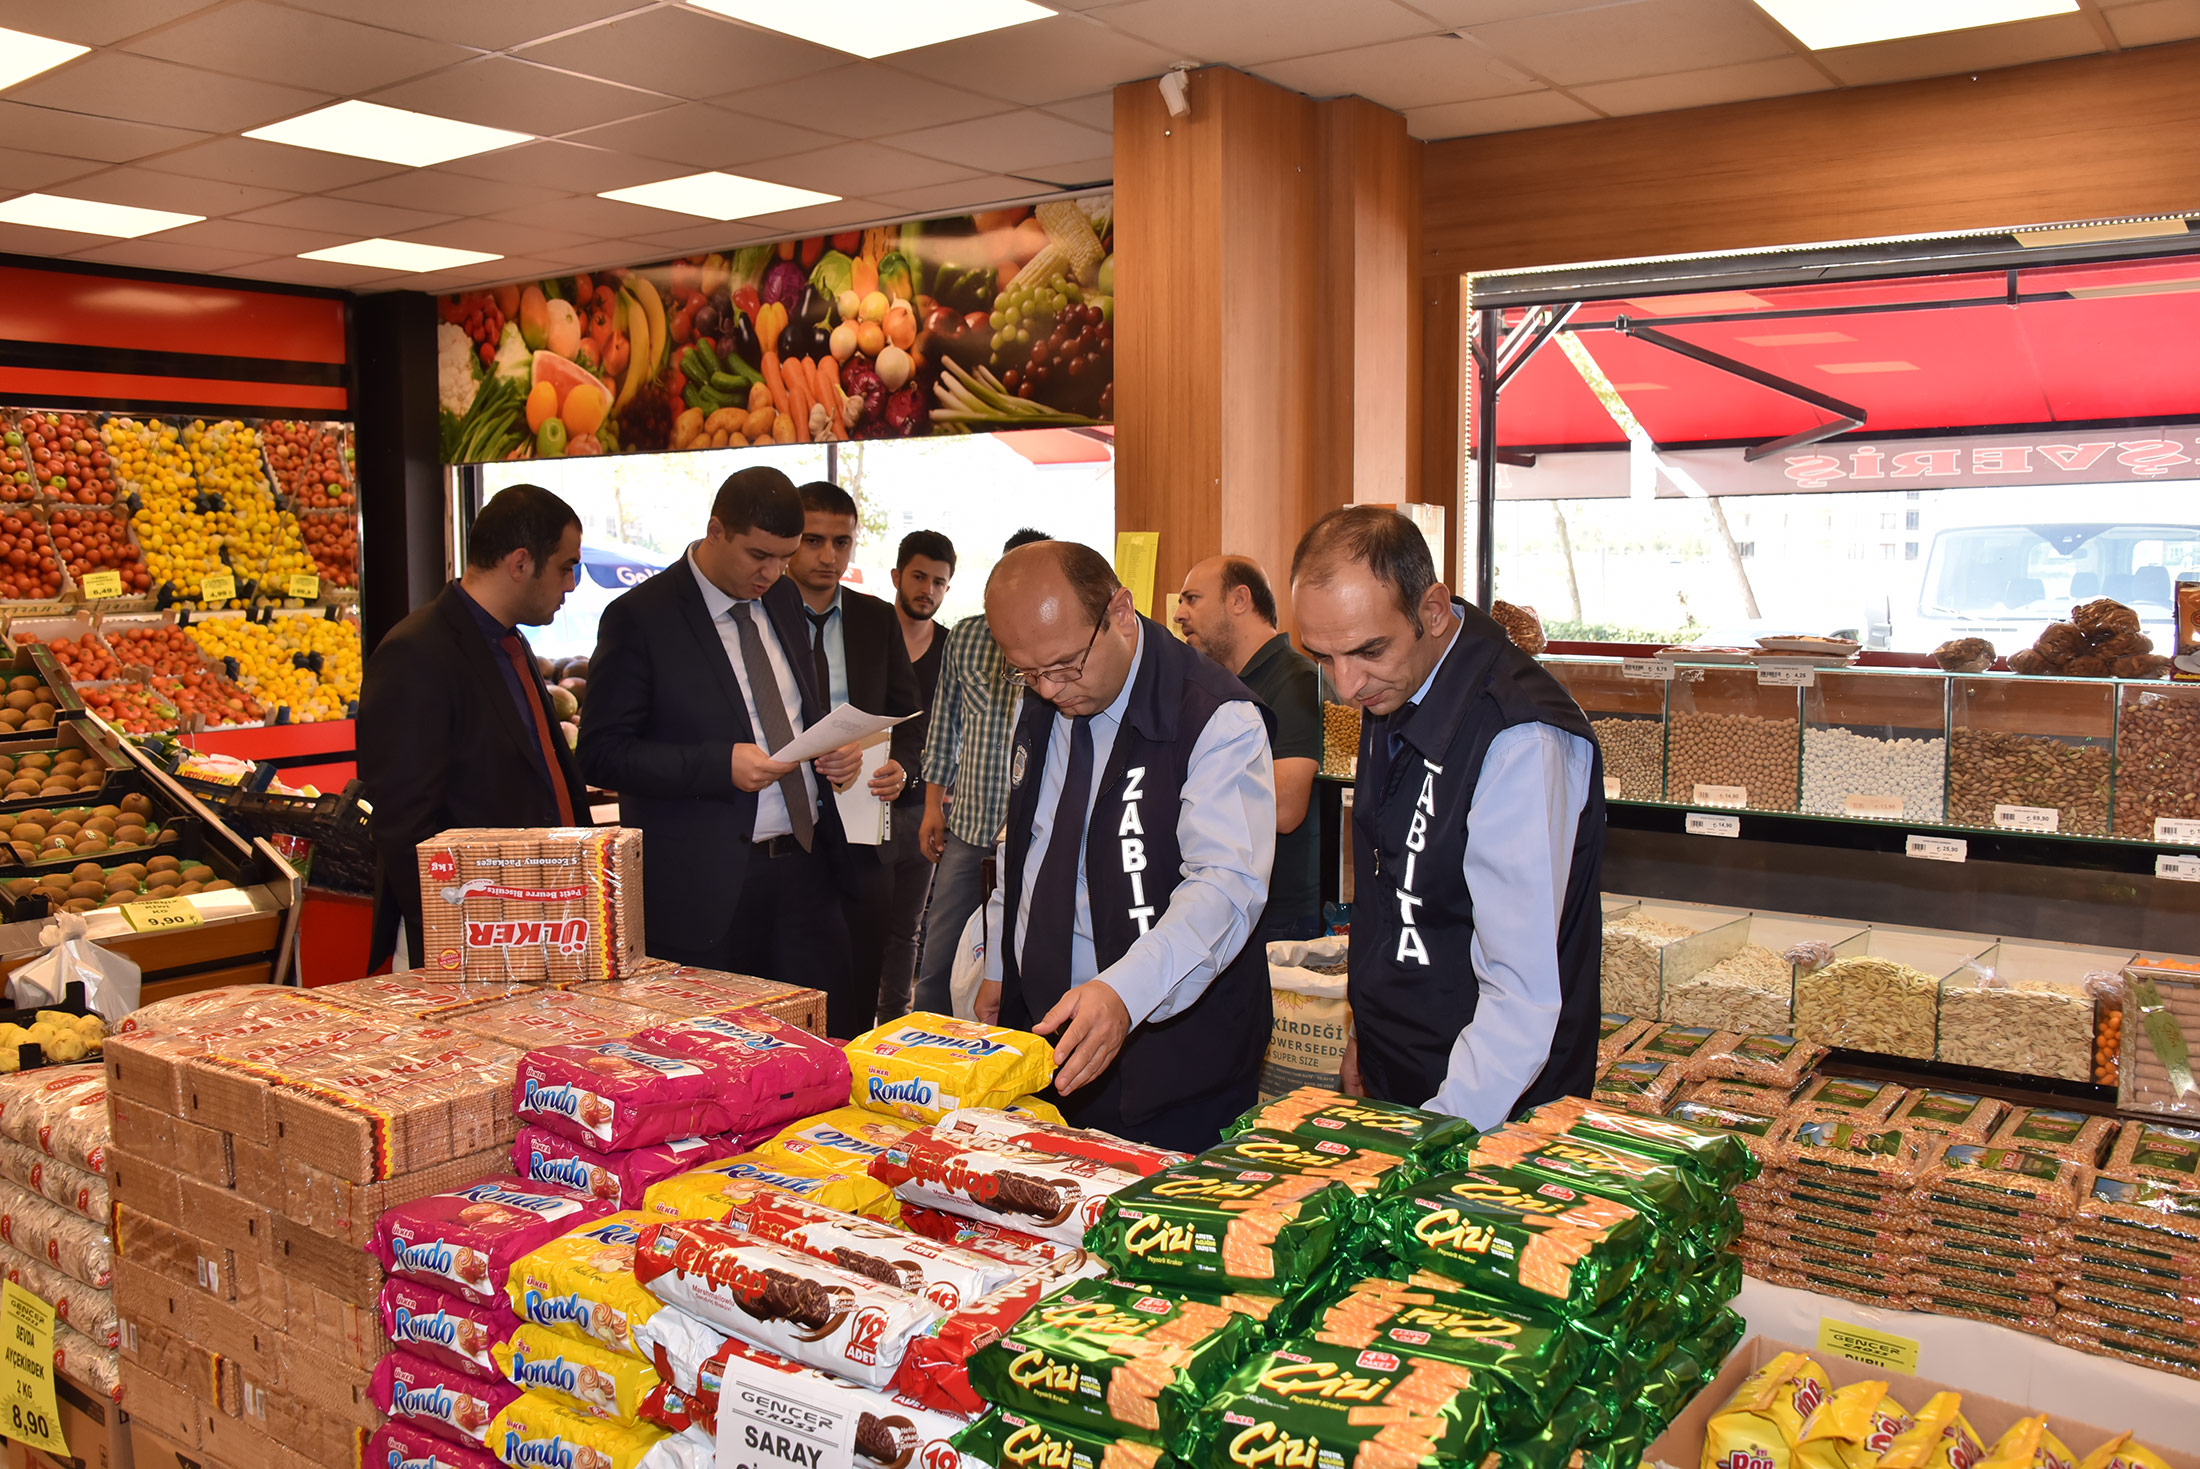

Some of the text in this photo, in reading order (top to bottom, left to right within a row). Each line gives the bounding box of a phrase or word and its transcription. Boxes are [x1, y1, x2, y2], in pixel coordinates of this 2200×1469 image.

[476, 858, 522, 868] Packages
[524, 857, 570, 868] Economy
[1394, 760, 1443, 966] ABITA
[486, 886, 523, 898] Biscuits
[525, 889, 558, 899] Beurre
[147, 915, 185, 927] 9,90
[466, 917, 590, 956] ÜLKER
[596, 1041, 685, 1072] Rondo
[899, 1030, 1007, 1057] Rondo
[868, 1065, 890, 1078] ÜLKER
[1272, 1050, 1298, 1064] SUPER
[1298, 1055, 1320, 1068] SIZE
[524, 1078, 578, 1116] Rondo
[867, 1075, 933, 1106] Rondo
[813, 1130, 886, 1157] ndo
[1233, 1142, 1341, 1167] Çizi
[2149, 1141, 2191, 1155] DURU
[529, 1150, 588, 1190] Rondo
[714, 1162, 825, 1195] Rond
[907, 1151, 1000, 1201] Çikilop
[1065, 1167, 1098, 1179] ADET
[456, 1184, 566, 1213] Rondo
[1151, 1178, 1263, 1198] Çizi
[1450, 1183, 1565, 1214] Çizi
[655, 1201, 680, 1217] ÜLKER
[1118, 1207, 1143, 1219] ÜLKER
[1414, 1197, 1443, 1212] ÜLKER
[1124, 1213, 1196, 1257] Çizi
[1414, 1208, 1497, 1255] Çizi
[391, 1237, 452, 1275] Rondo
[909, 1243, 938, 1259] ADET
[526, 1274, 549, 1292] ÜLKER
[673, 1239, 770, 1304] Çikilop
[395, 1292, 417, 1310] ÜLKER
[524, 1290, 590, 1329] Rondo
[395, 1306, 455, 1345] Rondo
[1041, 1303, 1158, 1335] Çizi
[1397, 1308, 1523, 1338] Çizi
[16, 1323, 35, 1349] SEVDA
[1000, 1339, 1027, 1353] ÜLKER
[5, 1345, 46, 1381] AYÇEKİRDEK
[846, 1345, 876, 1366] ADET
[1360, 1358, 1392, 1370] PAKET
[393, 1365, 415, 1385] ÜLKER
[512, 1352, 575, 1391] Rondo
[1008, 1348, 1080, 1393] Çizi
[1259, 1361, 1392, 1402] Çizi
[16, 1379, 33, 1400] 2 KG
[392, 1380, 452, 1419] Rondo
[12, 1404, 50, 1439] 8,90
[754, 1408, 818, 1433] GROSS
[1002, 1412, 1027, 1428] ÜLKER
[1224, 1410, 1255, 1427] ÜLKER
[504, 1431, 573, 1469] Rondo
[744, 1424, 824, 1469] SARAY
[1003, 1424, 1074, 1469] Çizi
[1228, 1420, 1319, 1469] Çizi
